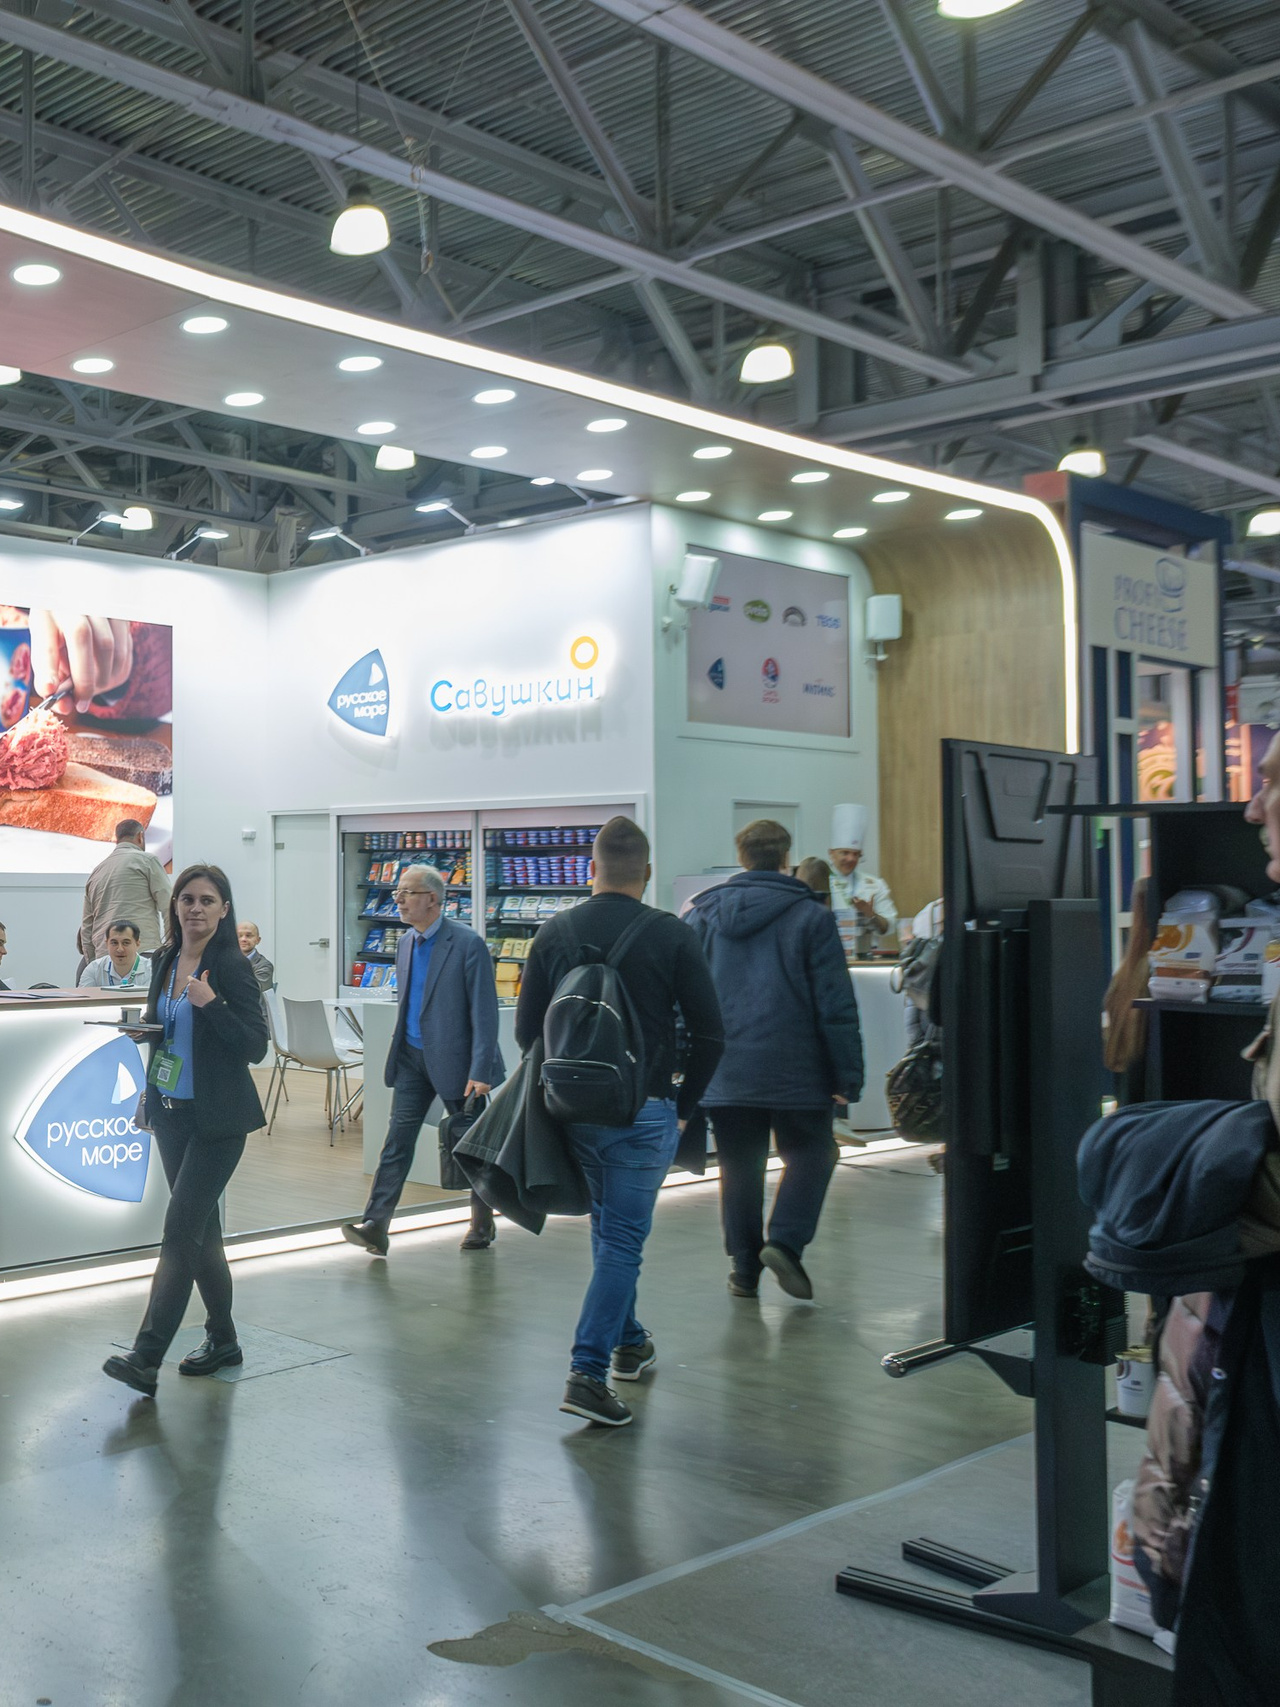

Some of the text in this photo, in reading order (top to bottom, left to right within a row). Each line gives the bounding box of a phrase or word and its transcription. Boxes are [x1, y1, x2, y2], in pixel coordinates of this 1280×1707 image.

[1114, 606, 1188, 651] CHEESE
[337, 690, 387, 709] русское
[430, 676, 593, 716] Савушкин
[354, 704, 387, 719] море
[47, 1116, 142, 1149] русское
[82, 1142, 143, 1169] море
